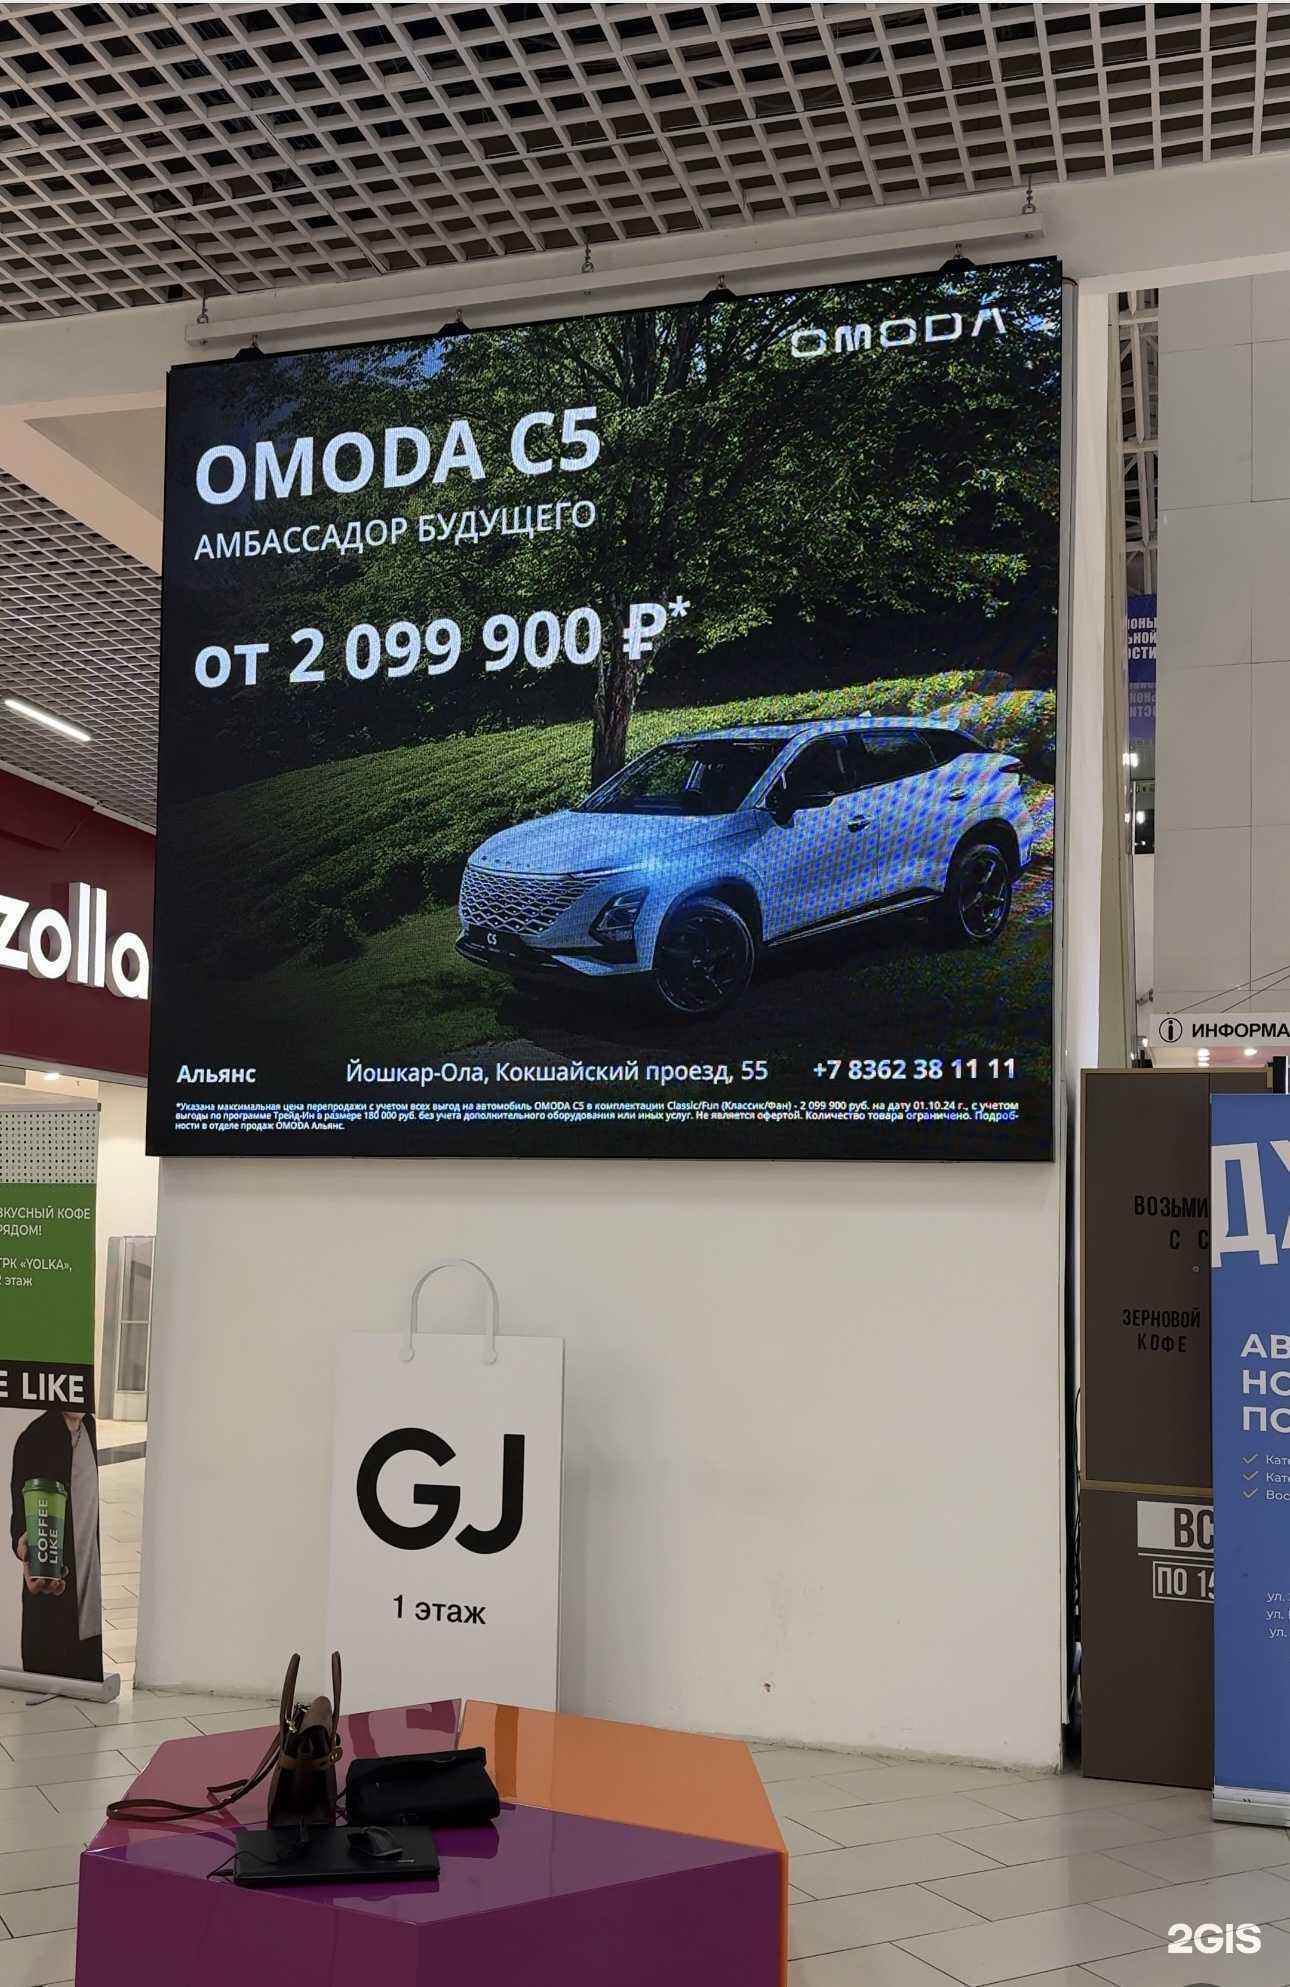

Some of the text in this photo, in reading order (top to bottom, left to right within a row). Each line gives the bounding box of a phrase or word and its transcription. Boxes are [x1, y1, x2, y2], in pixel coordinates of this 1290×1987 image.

[195, 406, 601, 505] OMODA C5
[194, 500, 597, 561] АМБАССАДОР БУДУЩЕГО
[1128, 617, 1157, 629] ОНЫ
[194, 644, 269, 689] от
[289, 628, 326, 684] 2
[345, 617, 463, 681] 099
[482, 606, 602, 672] 900
[0, 882, 149, 1000] zolla
[1192, 1023, 1290, 1038] ИНФОРМА
[176, 1065, 256, 1083] Альянс
[346, 1058, 769, 1087] Йошкар-Ола, Кокшайский проезд, 55
[813, 1058, 1015, 1080] +7 8362 38 11 11
[176, 1112, 208, 1121] выгоды
[210, 1112, 220, 1120] по
[223, 1112, 271, 1121] программе
[324, 1112, 362, 1121] размере
[364, 1112, 378, 1120] 180
[381, 1112, 397, 1120] 000
[398, 1112, 416, 1121] руб.
[419, 1112, 434, 1120] без
[436, 1112, 461, 1121] учета
[464, 1112, 545, 1121] дополнительного
[548, 1112, 614, 1121] оборудования
[617, 1111, 635, 1120] или
[638, 1111, 663, 1120] иных
[666, 1111, 694, 1121] услуг.
[696, 1111, 708, 1120] Не
[710, 1111, 755, 1120] является
[757, 1111, 802, 1121] офертой.
[806, 1111, 865, 1120] Количество
[868, 1111, 903, 1121] товара
[906, 1111, 972, 1121] ограничено.
[218, 1102, 280, 1111] максимальная
[283, 1102, 304, 1112] цена
[307, 1102, 366, 1112] перепродажи
[376, 1102, 408, 1112] учетом
[410, 1102, 430, 1111] всех
[432, 1102, 460, 1112] выгод
[462, 1102, 474, 1111] на
[476, 1102, 532, 1111] автомобиль
[534, 1102, 570, 1111] OMODA
[595, 1101, 664, 1112] комплектации
[667, 1101, 719, 1112] Classic/Fun
[722, 1101, 791, 1112] (Классик/Фан)
[800, 1101, 806, 1110] 2
[808, 1101, 826, 1110] 099
[829, 1101, 846, 1110] 900
[848, 1101, 870, 1112] руб.
[872, 1101, 885, 1110] на
[888, 1101, 910, 1112] дату
[913, 1101, 955, 1110] 01.10.24
[980, 1101, 1018, 1112] учетом
[175, 1122, 200, 1130] ности
[209, 1122, 239, 1131] отделе
[241, 1122, 273, 1131] продаж
[276, 1122, 308, 1130] OMODA
[311, 1122, 344, 1130] Альянс.
[57, 1208, 91, 1219] КОФЕ
[5, 1276, 32, 1286] этаж
[1122, 1308, 1200, 1328] ЗЕРНОВОЙ
[1137, 1333, 1187, 1353] КОФЕ
[22, 1371, 85, 1404] LIKE
[1266, 1455, 1290, 1465] Кат
[1266, 1472, 1290, 1482] Кат
[356, 1427, 526, 1555] GJ
[37, 1499, 48, 1563] COFFEE
[49, 1528, 58, 1564] LIKE
[1157, 1566, 1188, 1596] ПО
[393, 1594, 486, 1625] 1 этаж
